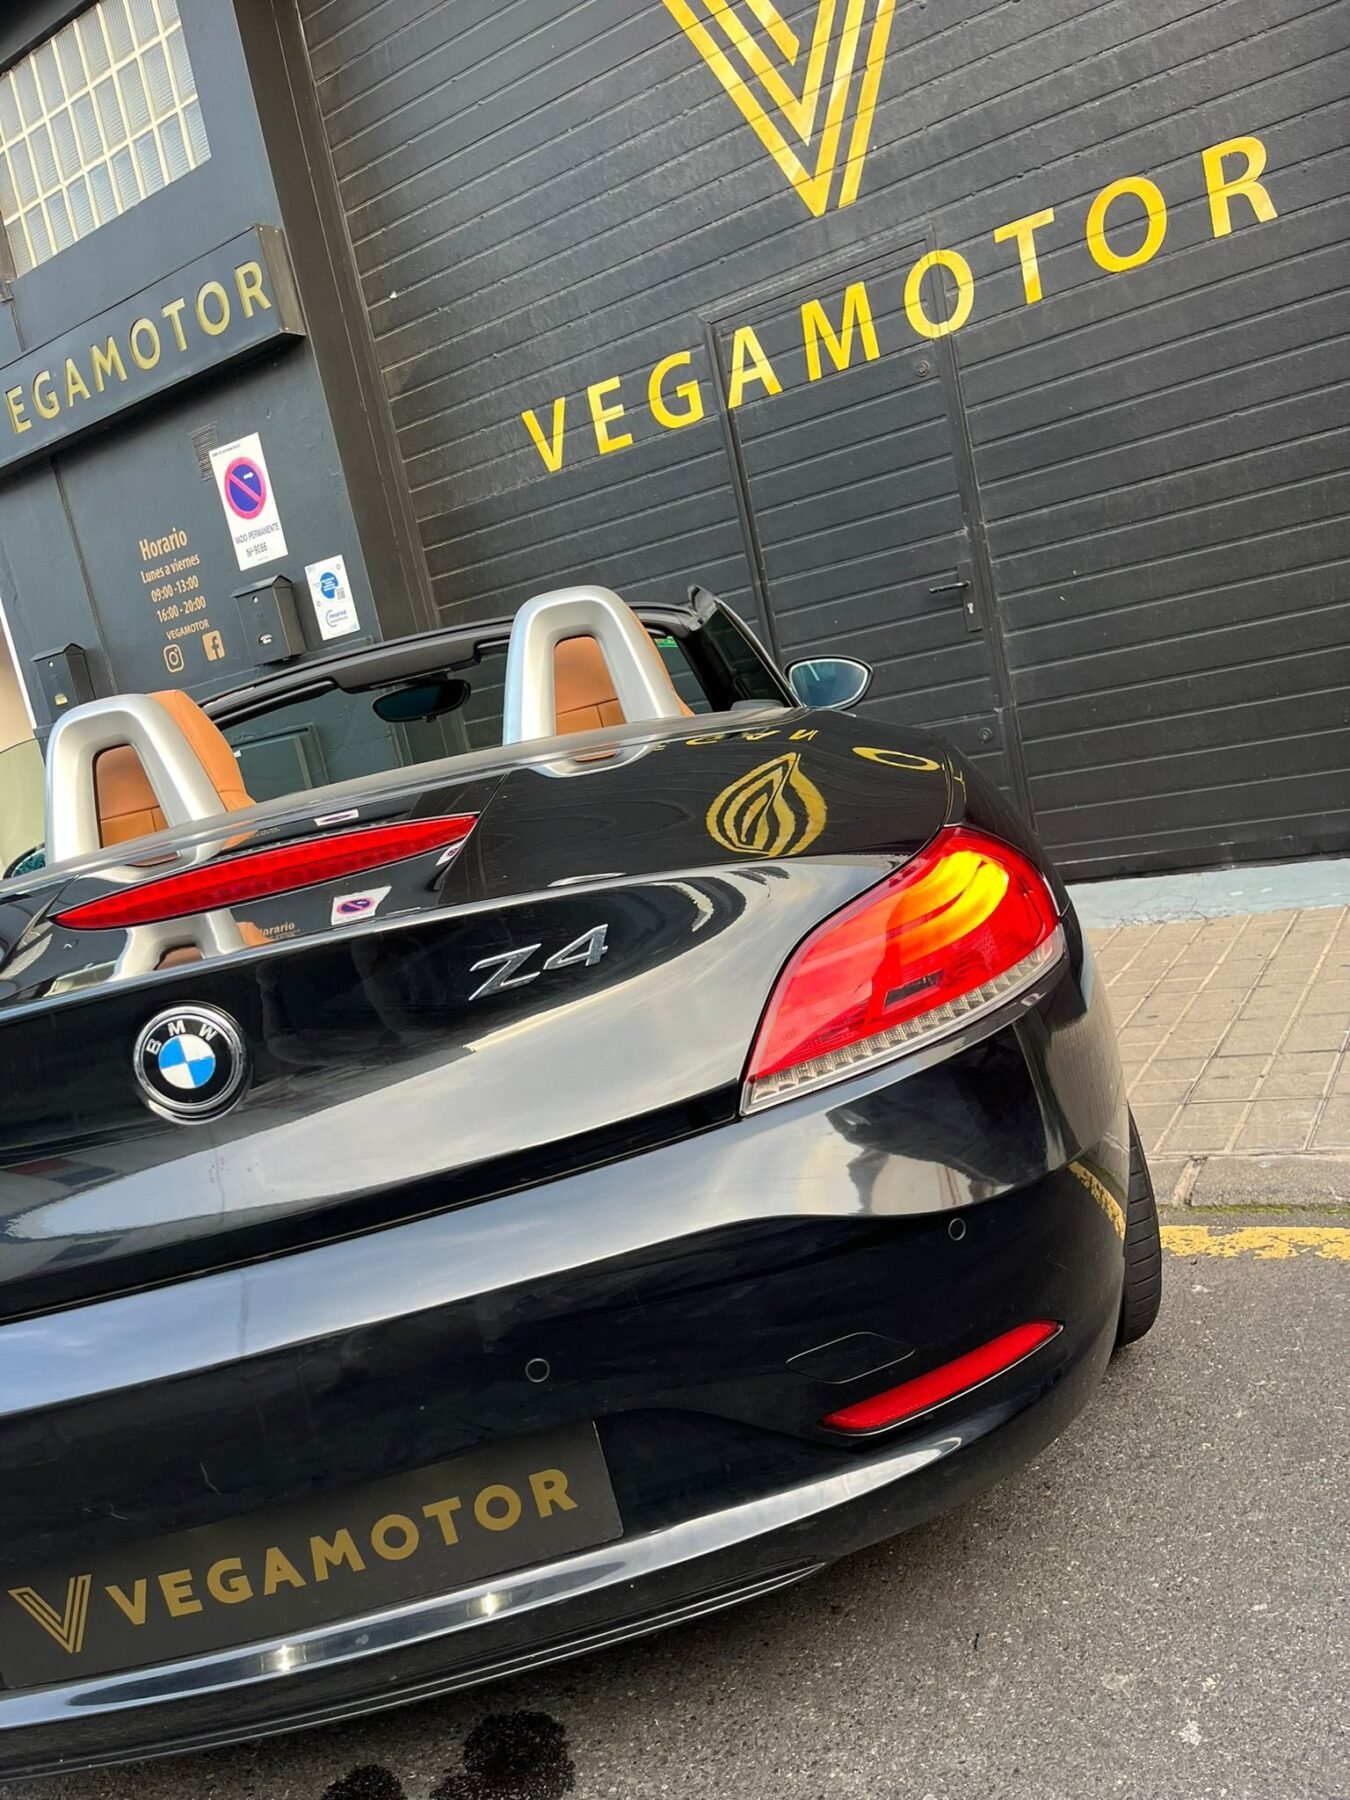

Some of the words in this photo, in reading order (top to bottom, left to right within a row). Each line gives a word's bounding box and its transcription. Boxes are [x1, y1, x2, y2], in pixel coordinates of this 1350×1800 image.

[521, 136, 1278, 473] VEGAMOTOR
[5, 261, 272, 434] EGAMOTOR
[139, 527, 188, 561] Horario
[234, 533, 248, 545] VADO
[248, 522, 280, 540] PERMANENTE
[141, 567, 165, 584] Lunes
[165, 565, 171, 576] a
[171, 554, 200, 574] viernes
[151, 584, 174, 603] 09:00
[156, 604, 179, 623] 16:00
[183, 595, 207, 615] 20:00
[166, 619, 210, 640] VEGAMOTOR
[468, 923, 609, 1001] Z4
[146, 1020, 218, 1055] BMW
[105, 1468, 578, 1625] VEGAMOTOR
